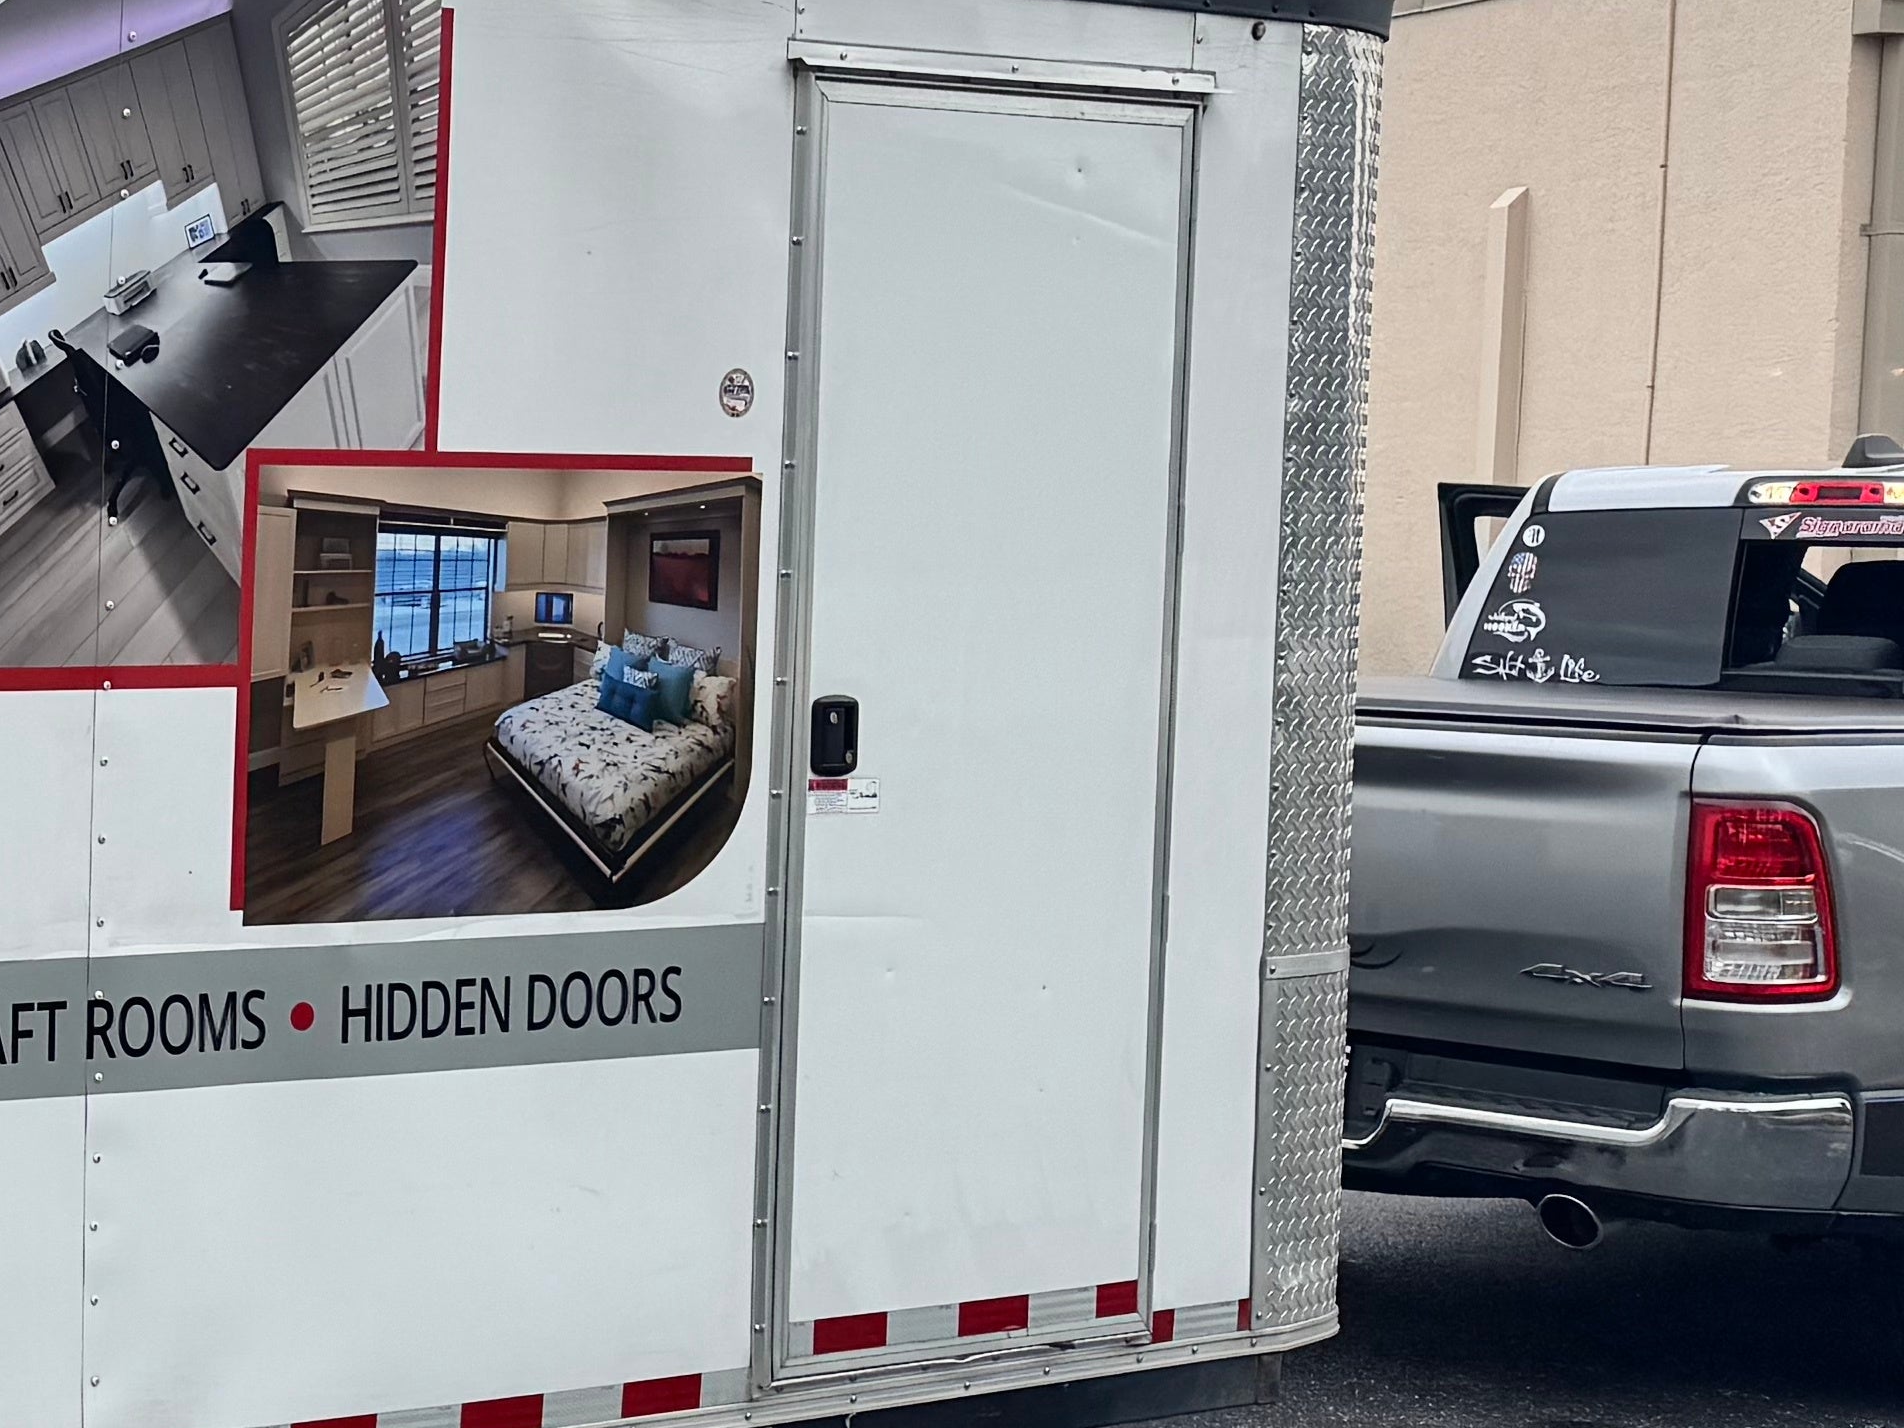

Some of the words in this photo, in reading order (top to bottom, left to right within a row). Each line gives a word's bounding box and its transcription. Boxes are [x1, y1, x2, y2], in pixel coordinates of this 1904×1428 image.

[85, 989, 266, 1060] ROOMS
[341, 975, 511, 1044] HIDDEN
[526, 965, 682, 1032] DOORS
